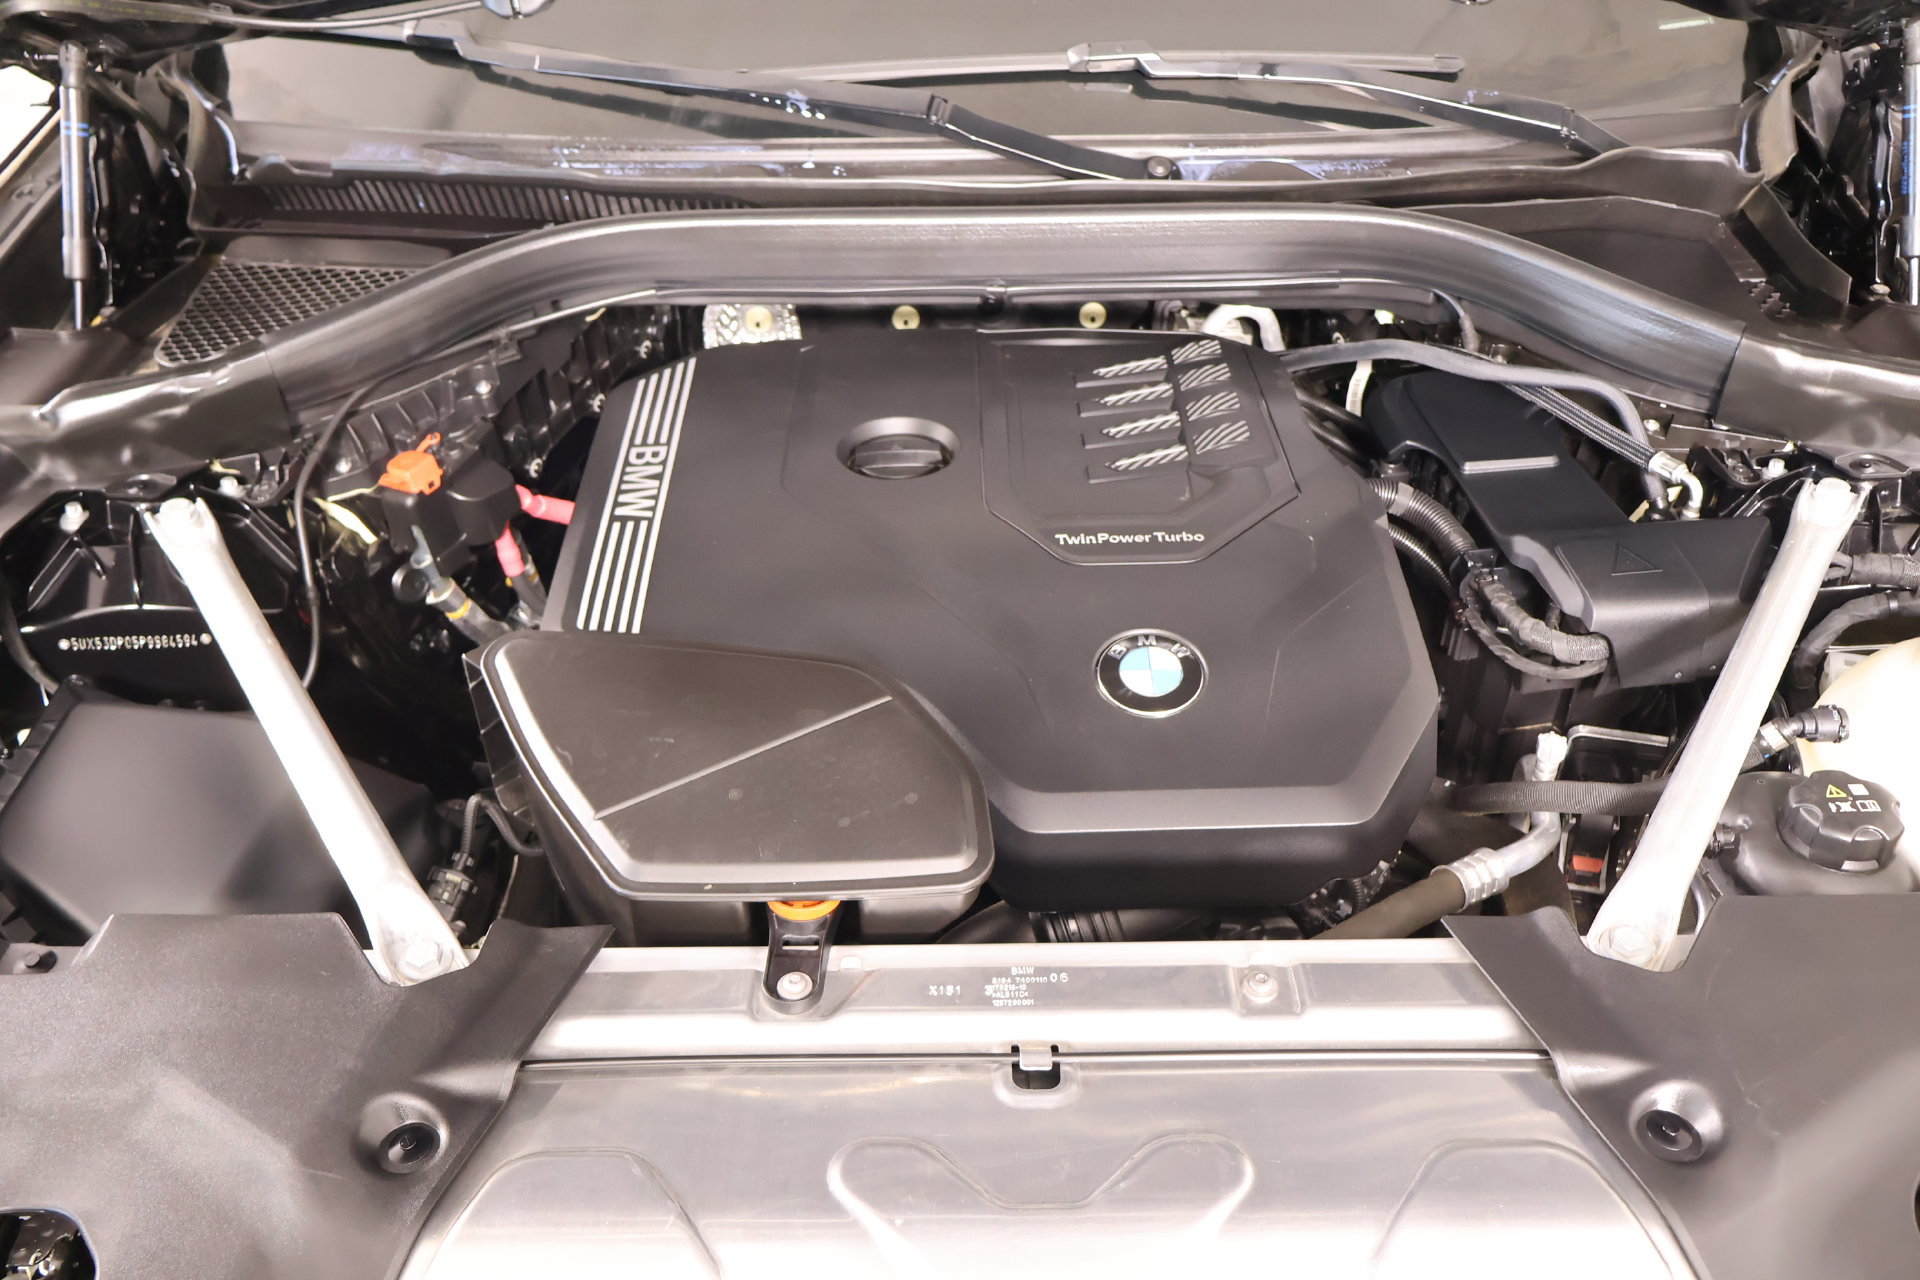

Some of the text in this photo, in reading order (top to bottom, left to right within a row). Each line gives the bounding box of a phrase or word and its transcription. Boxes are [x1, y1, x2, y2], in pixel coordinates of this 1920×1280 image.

[614, 445, 668, 518] BMW
[1054, 531, 1205, 545] TwinPower Turbo
[1107, 635, 1195, 660] BMW
[1011, 966, 1035, 976] BMW
